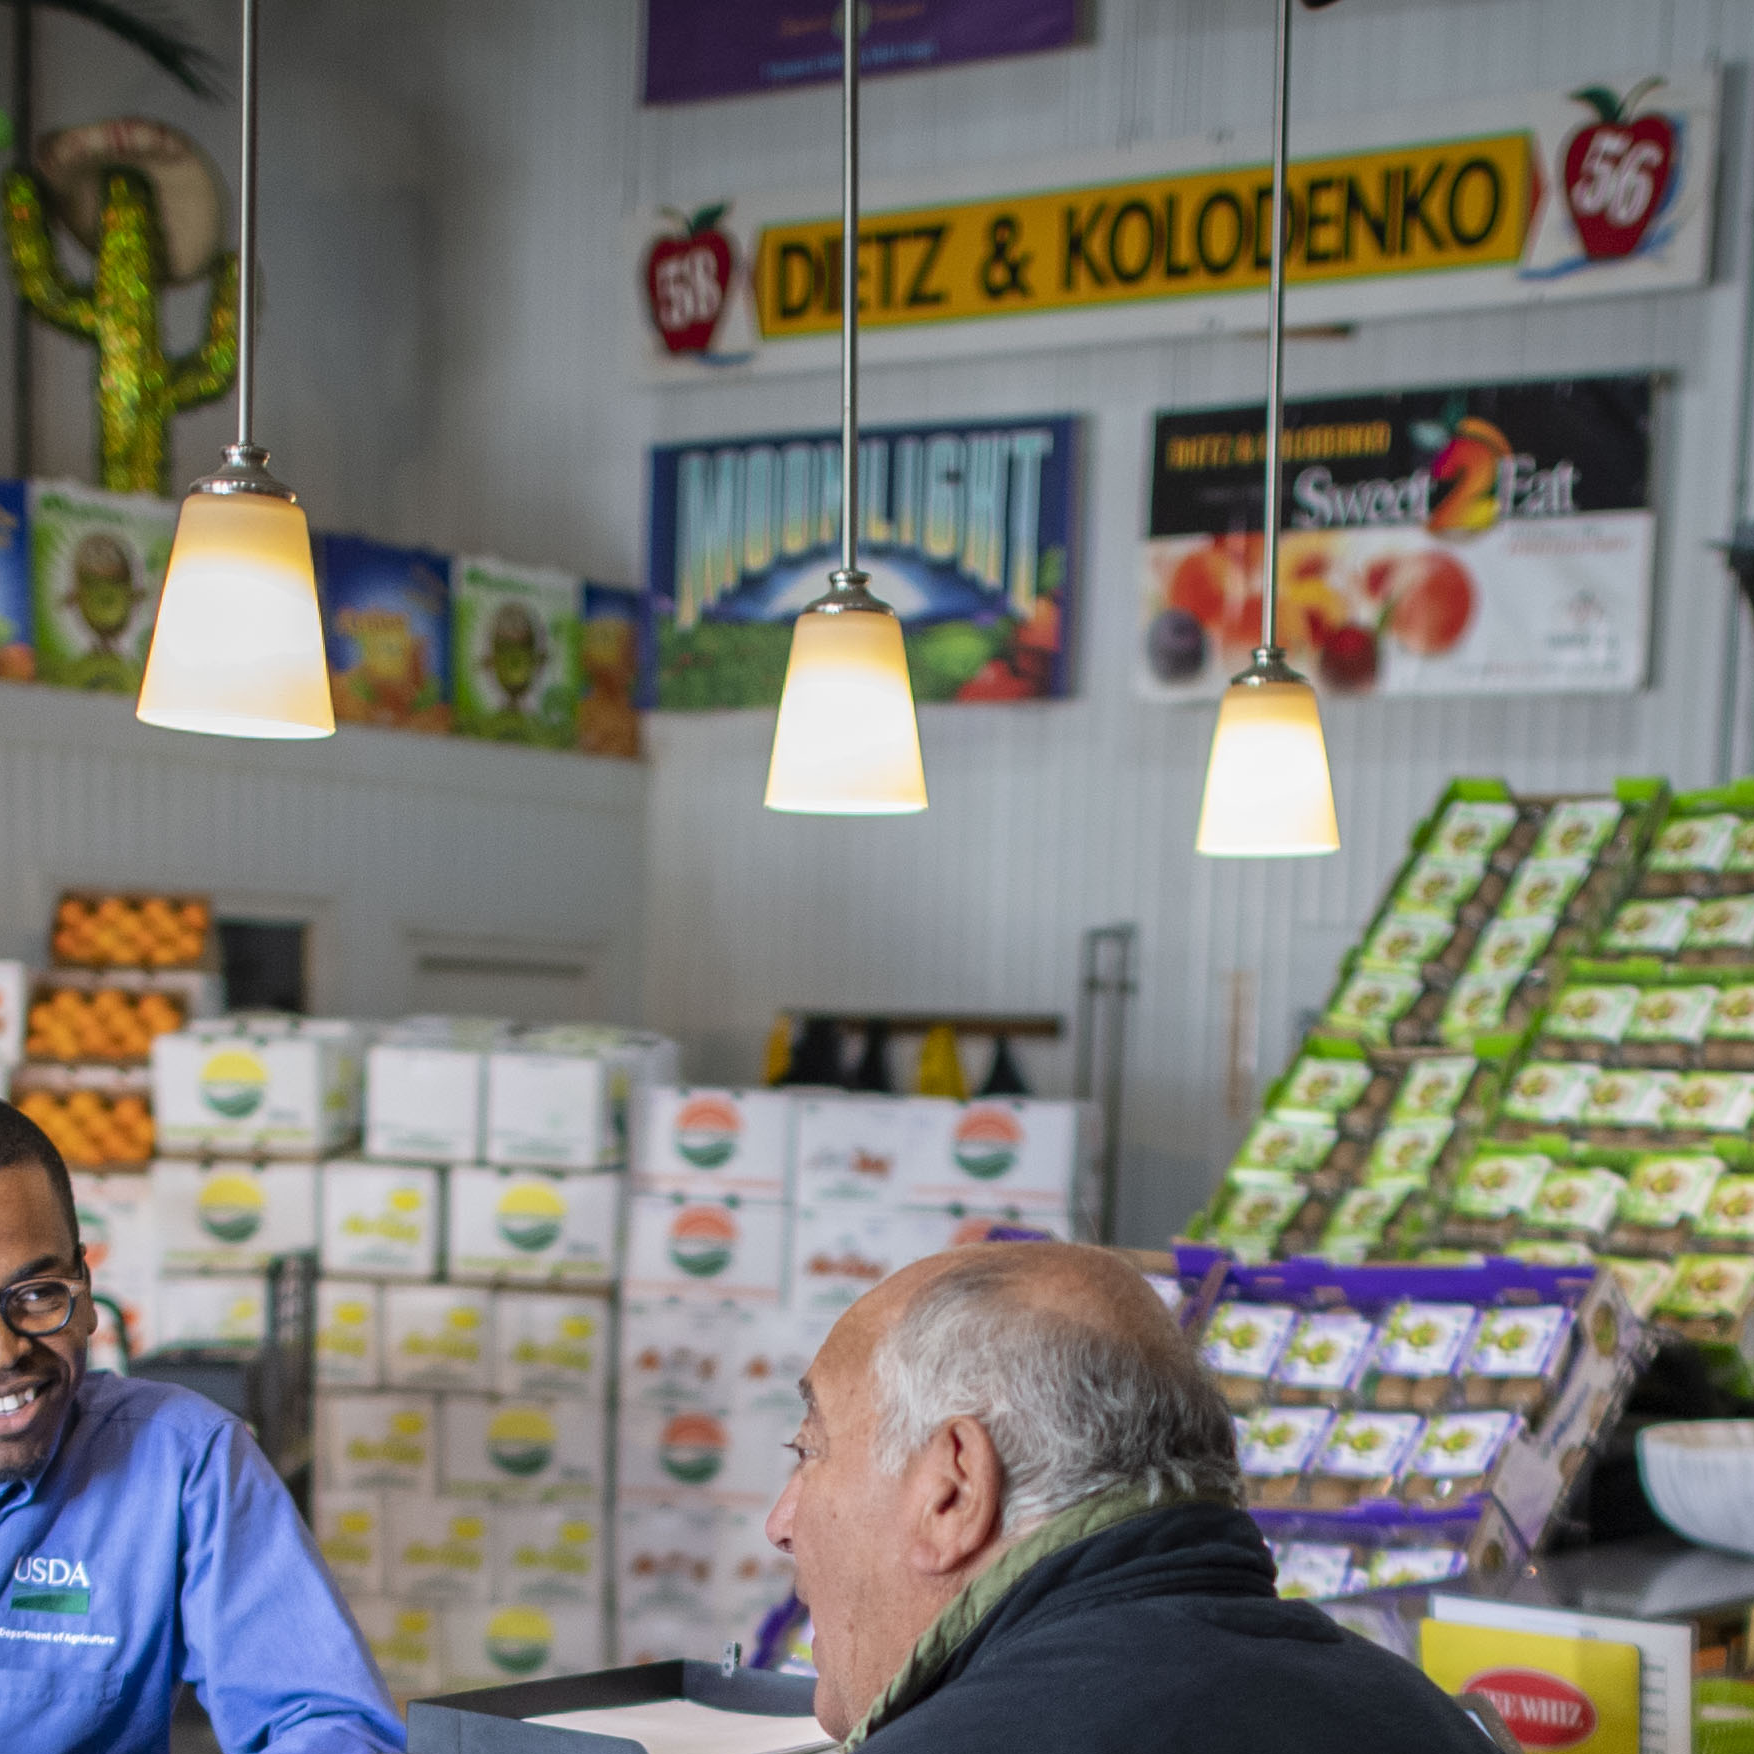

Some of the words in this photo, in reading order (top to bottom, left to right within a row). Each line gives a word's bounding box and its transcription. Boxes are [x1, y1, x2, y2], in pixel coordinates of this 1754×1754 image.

[1571, 131, 1659, 224] 56
[780, 225, 949, 319] DIETZ
[981, 214, 1032, 298] &
[1063, 155, 1502, 290] KOLODENKO
[1292, 464, 1435, 529] Sweet
[677, 430, 1054, 633] MOONLIGHT
[14, 1557, 90, 1588] USDA
[0, 1627, 51, 1642] Department
[53, 1631, 64, 1642] of
[65, 1633, 117, 1646] Agriculture
[1519, 1694, 1584, 1729] WHIZ
